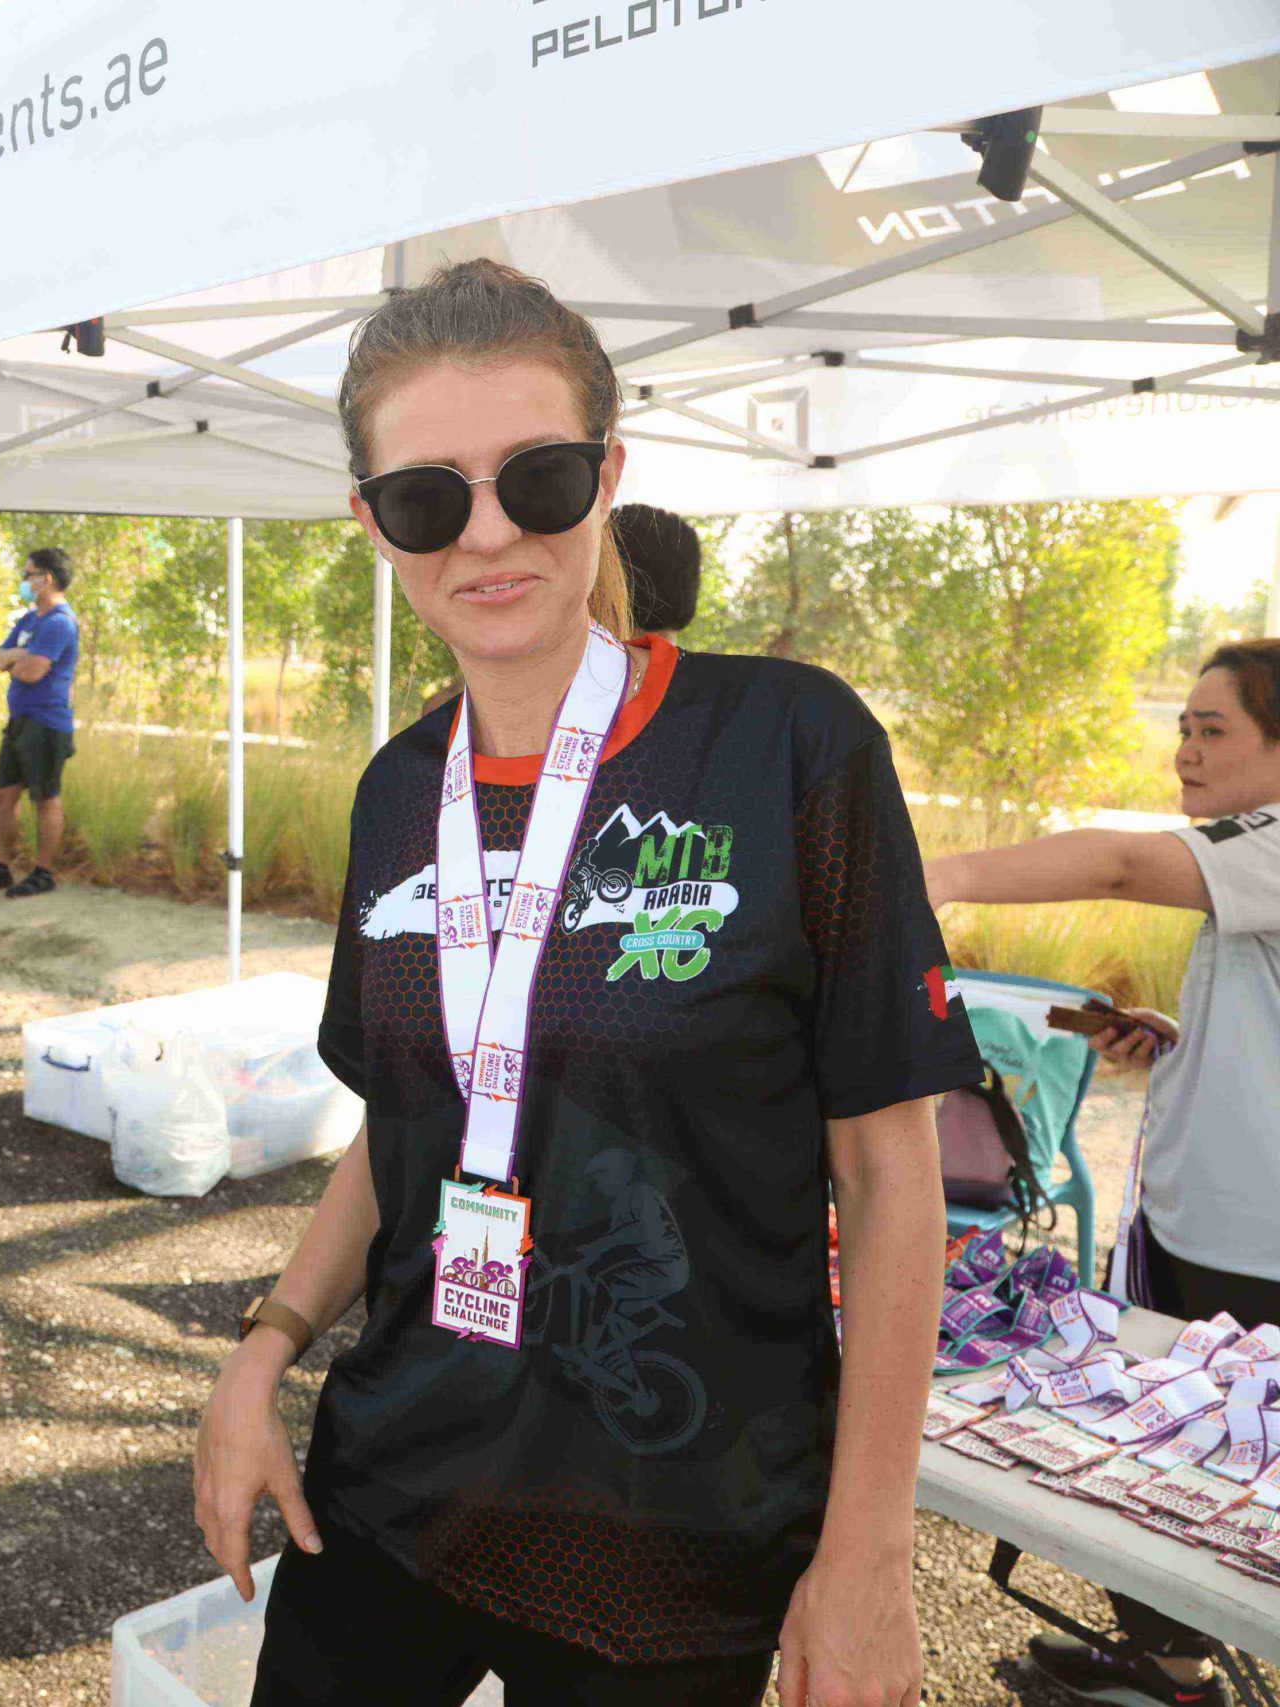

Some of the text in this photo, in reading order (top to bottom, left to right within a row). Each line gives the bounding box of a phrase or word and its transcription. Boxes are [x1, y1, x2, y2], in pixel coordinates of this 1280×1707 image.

[531, 0, 768, 68] PELOTO
[634, 825, 734, 888] MTB
[514, 892, 530, 929] CYCLING
[643, 882, 713, 911] ARABIA
[465, 904, 475, 939] CYCLING
[626, 933, 698, 949] CROSS COUNTRY
[484, 1053, 495, 1088] CYCLING
[450, 1196, 518, 1223] COMMUNITY
[443, 1304, 508, 1332] CHALLENGE
[445, 1288, 510, 1319] CYCLING
